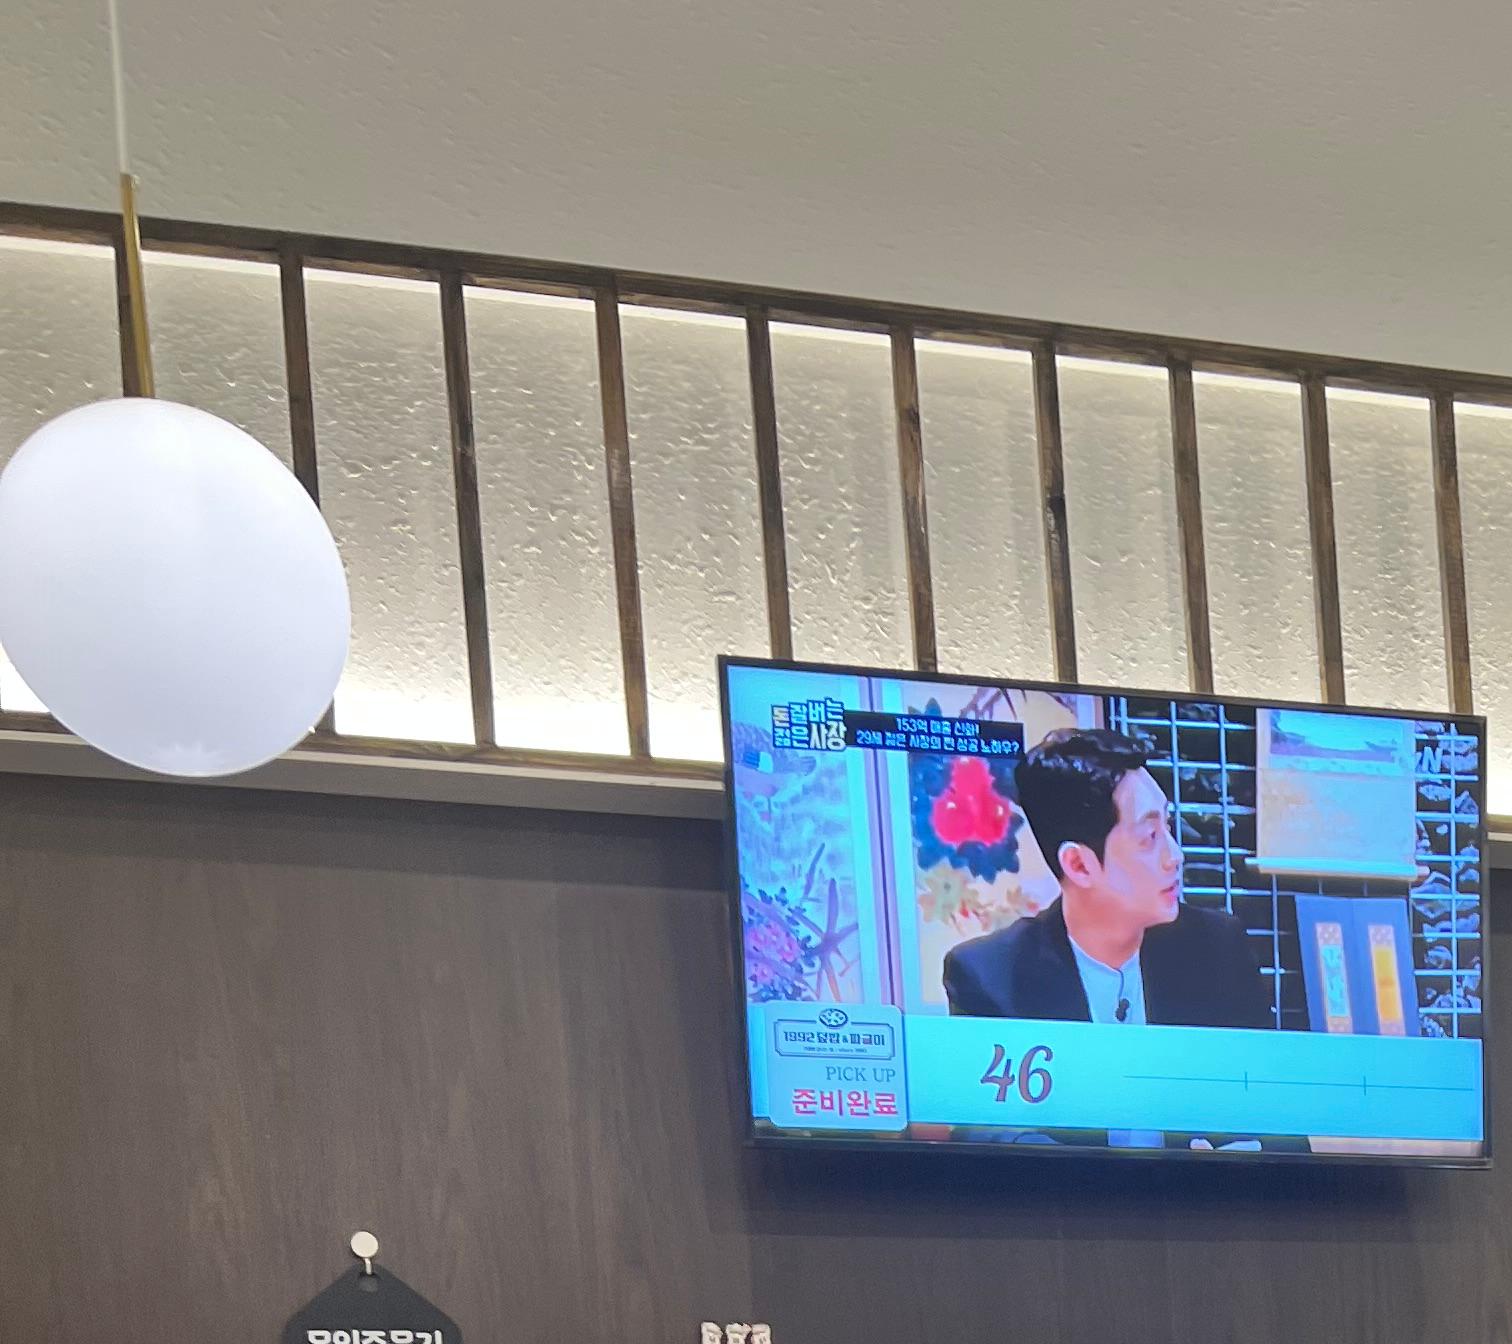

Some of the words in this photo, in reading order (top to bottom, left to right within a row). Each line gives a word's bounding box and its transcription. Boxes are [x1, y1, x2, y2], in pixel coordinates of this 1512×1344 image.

[896, 718, 928, 733] 153억
[856, 730, 883, 745] 29세
[826, 1066, 867, 1082] PICK
[873, 1067, 896, 1083] UP
[980, 1044, 1053, 1104] 46
[792, 1088, 898, 1117] 준비완료
